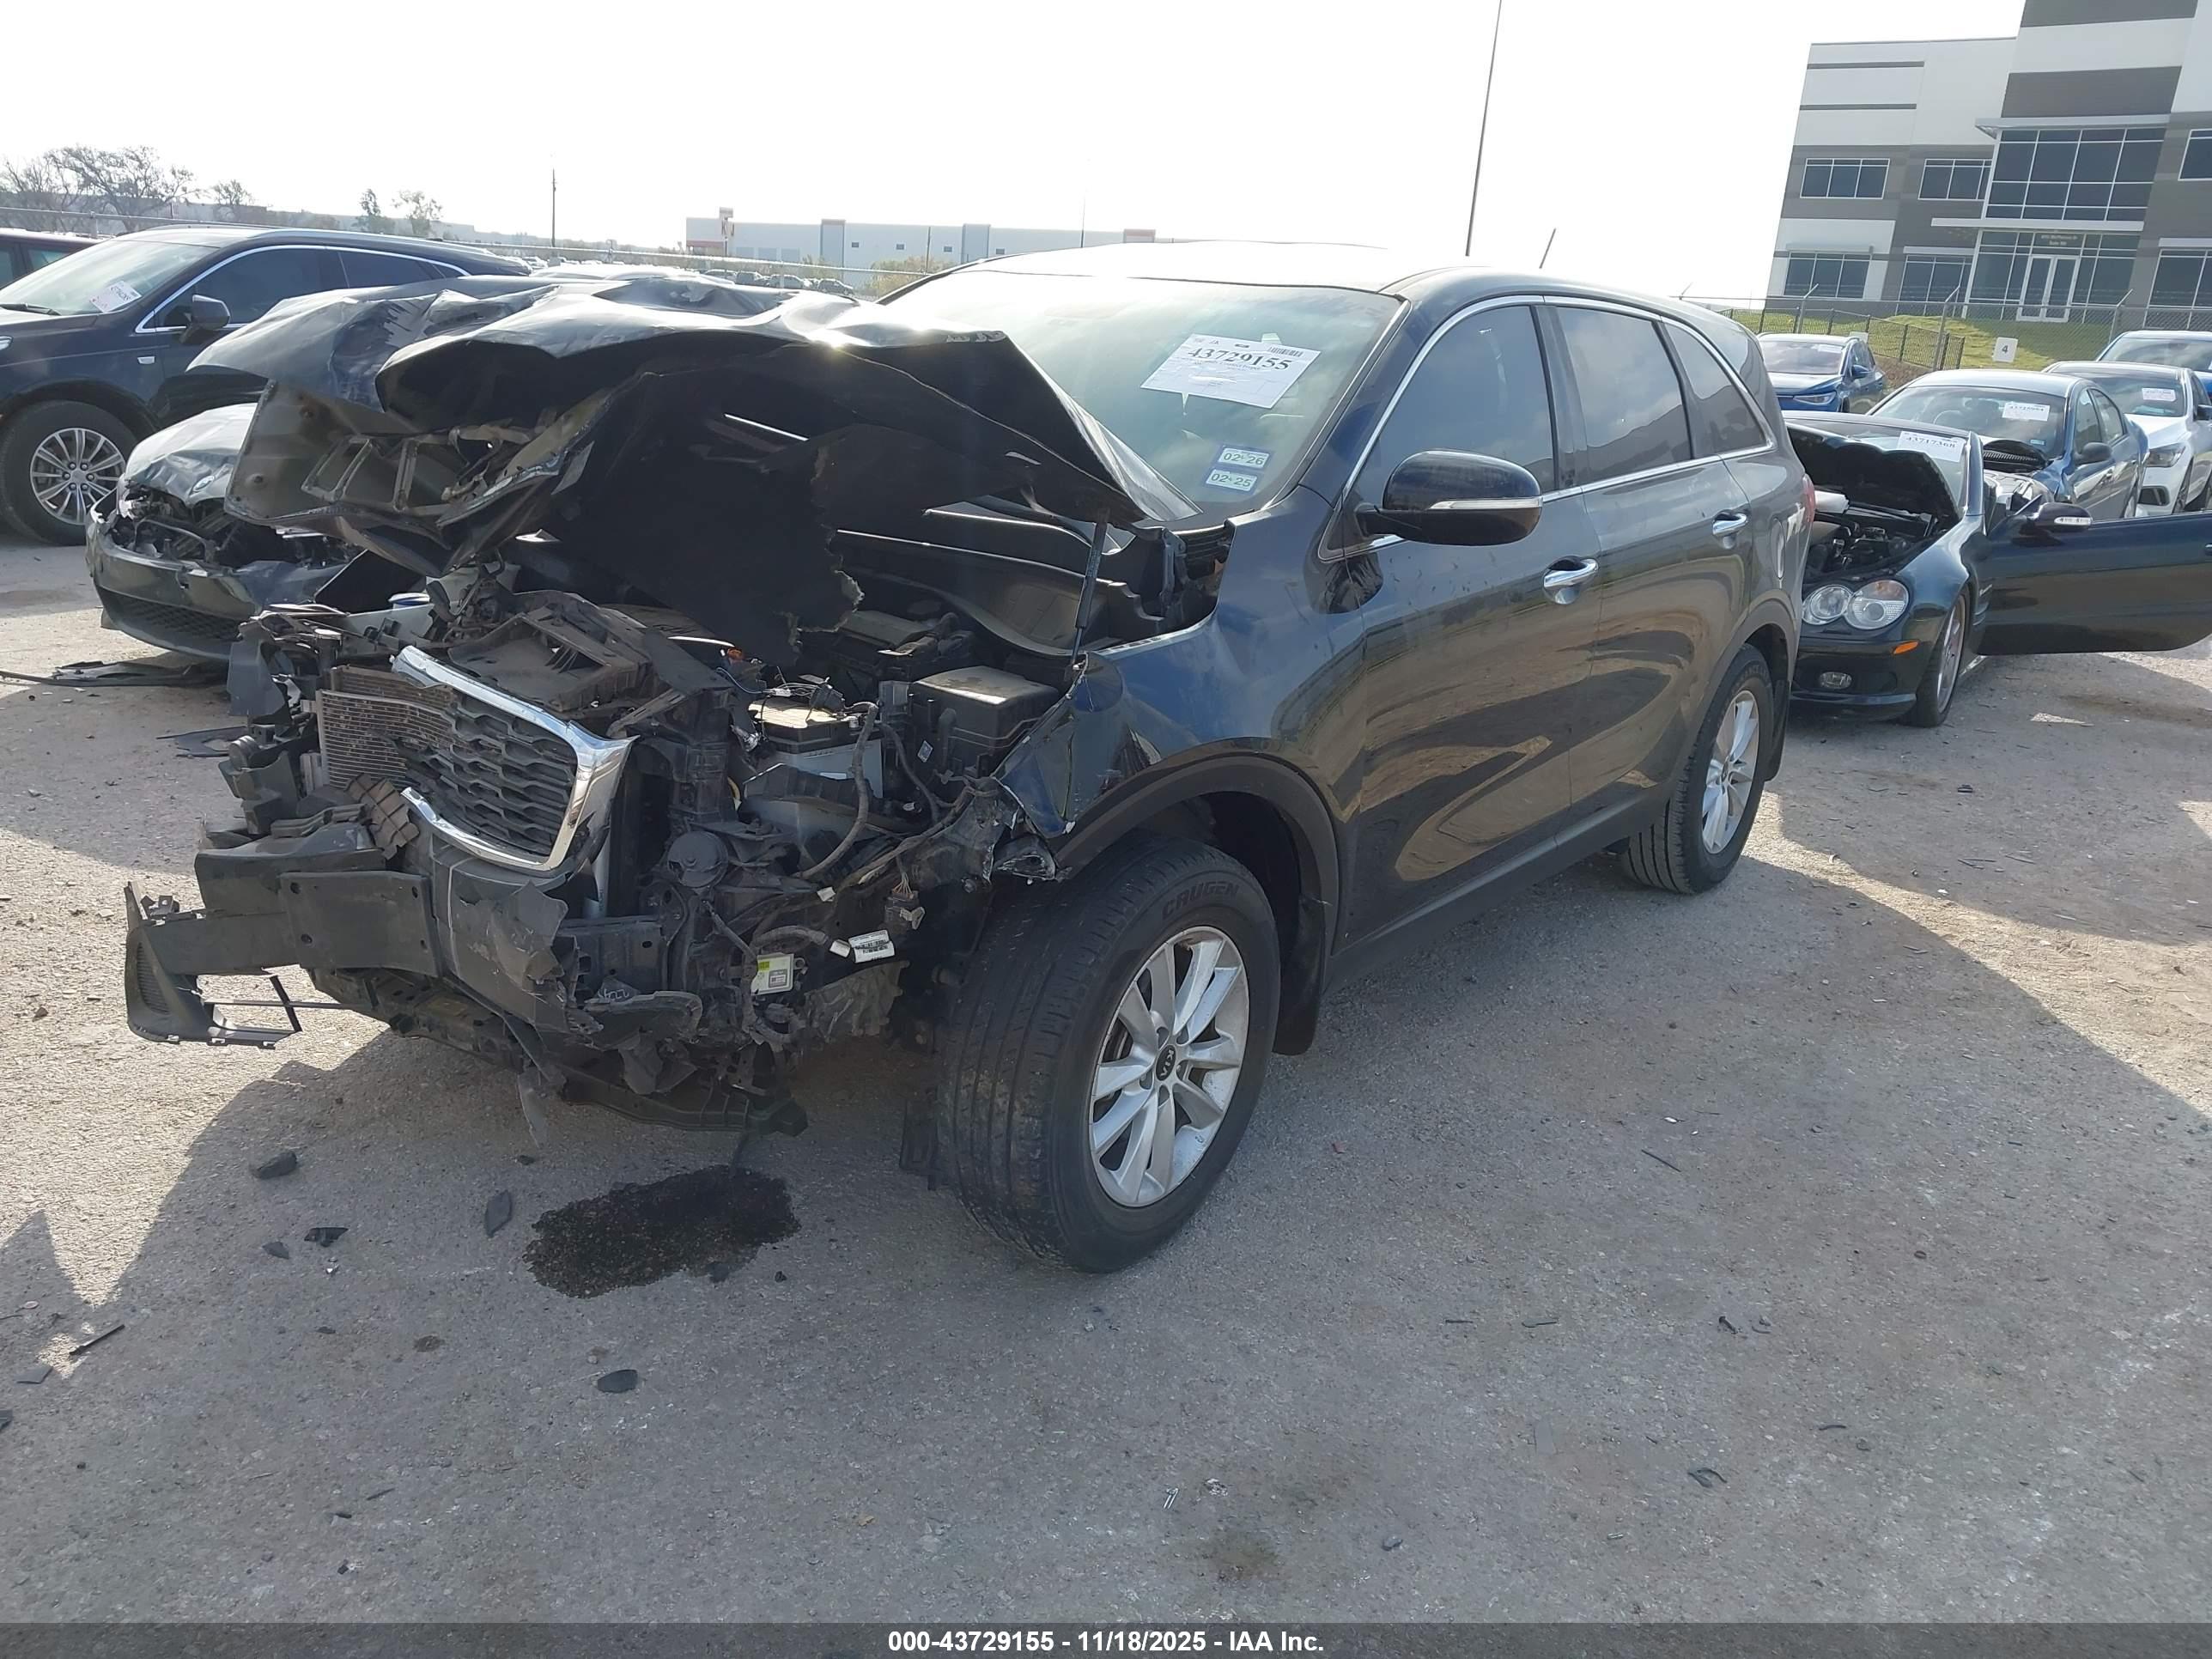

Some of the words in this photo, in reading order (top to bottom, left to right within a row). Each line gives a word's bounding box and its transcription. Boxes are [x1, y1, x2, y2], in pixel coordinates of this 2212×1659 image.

[1188, 347, 1293, 370] 43729155
[2002, 345, 2009, 354] 4
[1160, 1049, 1175, 1076] KIA
